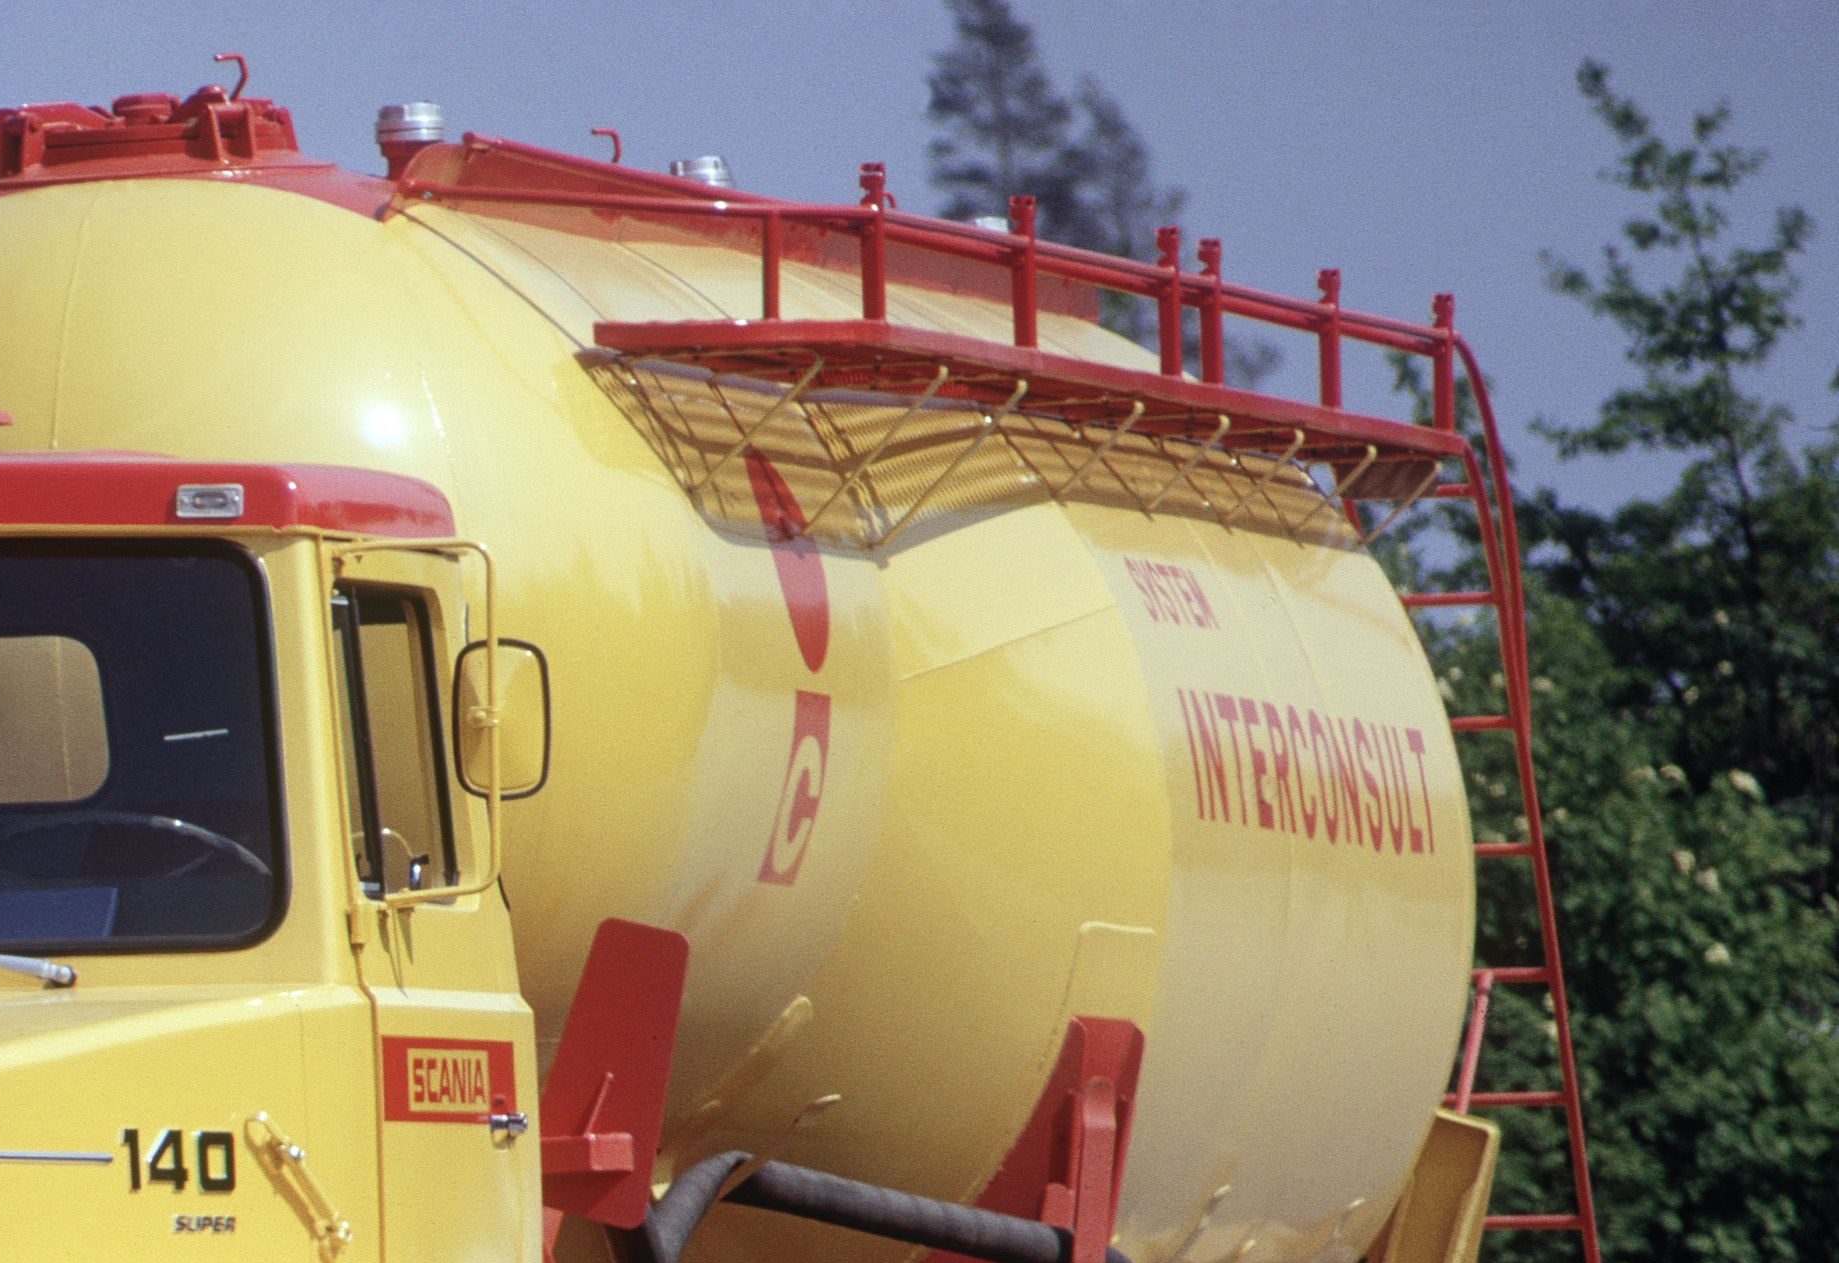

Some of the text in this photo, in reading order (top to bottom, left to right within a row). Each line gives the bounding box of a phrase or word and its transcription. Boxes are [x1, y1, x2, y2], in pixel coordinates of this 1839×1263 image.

[1123, 556, 1221, 631] SYSTEM
[1176, 687, 1435, 856] INTERCONSULT
[412, 1058, 487, 1106] SCANIA
[119, 1127, 237, 1193] 140
[172, 1214, 237, 1234] SUPER
